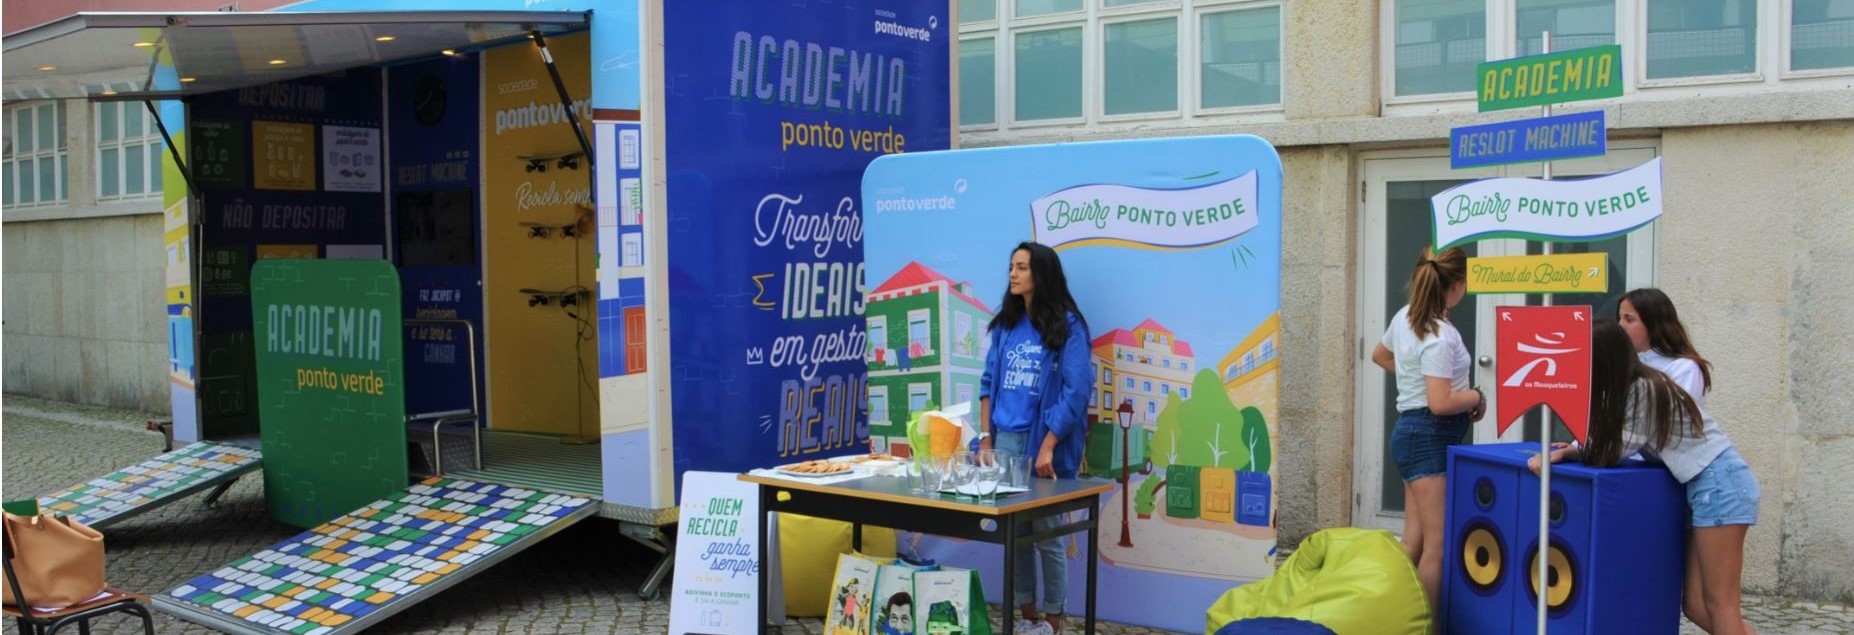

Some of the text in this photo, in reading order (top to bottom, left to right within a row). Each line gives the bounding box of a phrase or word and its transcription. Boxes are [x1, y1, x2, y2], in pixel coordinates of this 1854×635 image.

[875, 20, 930, 41] pontoverde
[729, 30, 905, 118] ACADEMIA
[1482, 53, 1612, 102] ACADEMIA
[781, 121, 904, 153] ponto verde
[1458, 120, 1599, 158] RESLOT MACHINE
[221, 198, 348, 230] NÃO DEPOSITAR
[876, 196, 956, 213] pontoverde
[1046, 198, 1245, 231] Bairro PONTO VERDE
[1446, 186, 1650, 225] Bairro PONTO VERDE
[782, 262, 867, 319] IDEAIS
[1472, 264, 1517, 284] Mural
[1534, 263, 1582, 288] Bairro
[267, 304, 382, 361] ACADEMIA
[770, 336, 808, 367] em
[297, 367, 383, 395] ponto verde
[1534, 381, 1578, 390] Mosqueteiros
[777, 373, 869, 457] REAIS
[708, 497, 744, 516] QUEM
[686, 517, 738, 537] RECICLA
[701, 537, 752, 560] ganha
[710, 556, 760, 579] sempre
